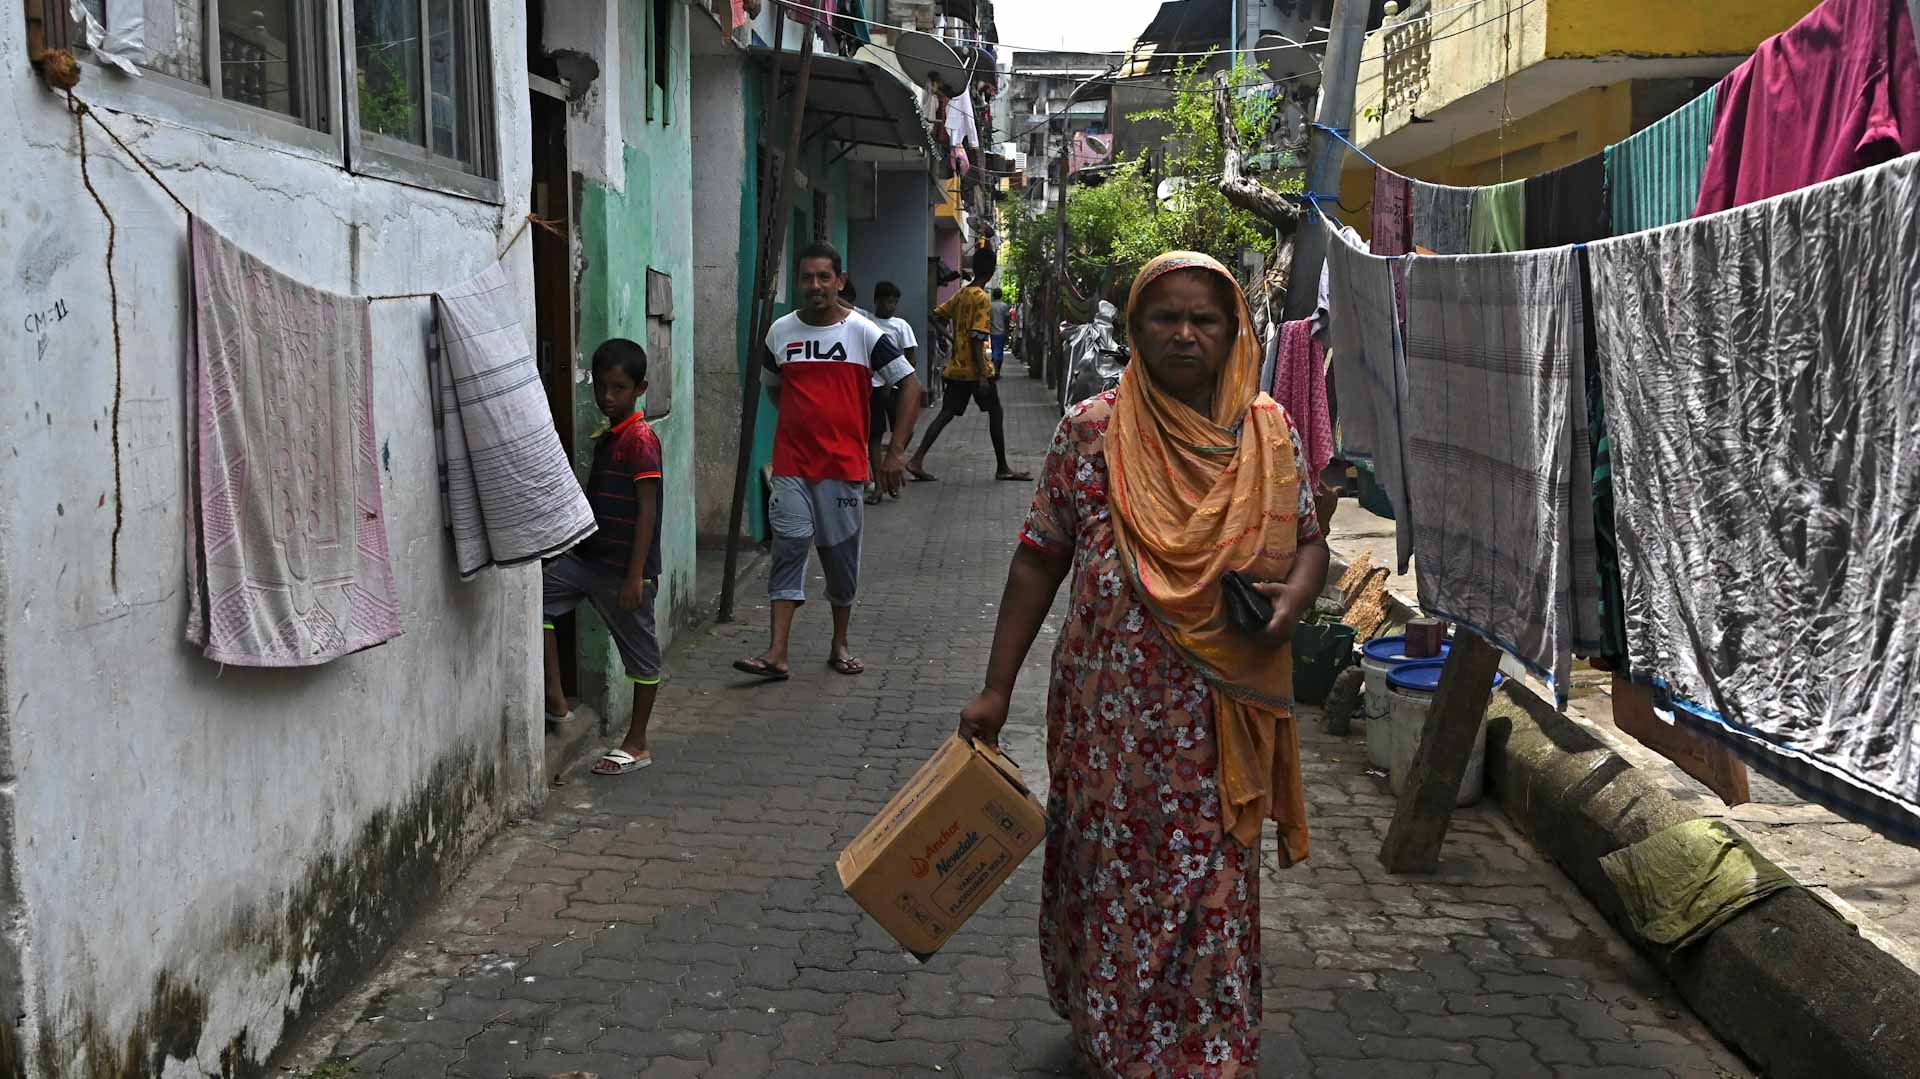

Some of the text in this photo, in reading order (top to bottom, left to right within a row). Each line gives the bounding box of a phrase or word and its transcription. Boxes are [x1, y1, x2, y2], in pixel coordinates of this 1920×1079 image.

[786, 340, 847, 361] FILA
[925, 820, 961, 858] Anchor
[935, 831, 978, 878] Newdale
